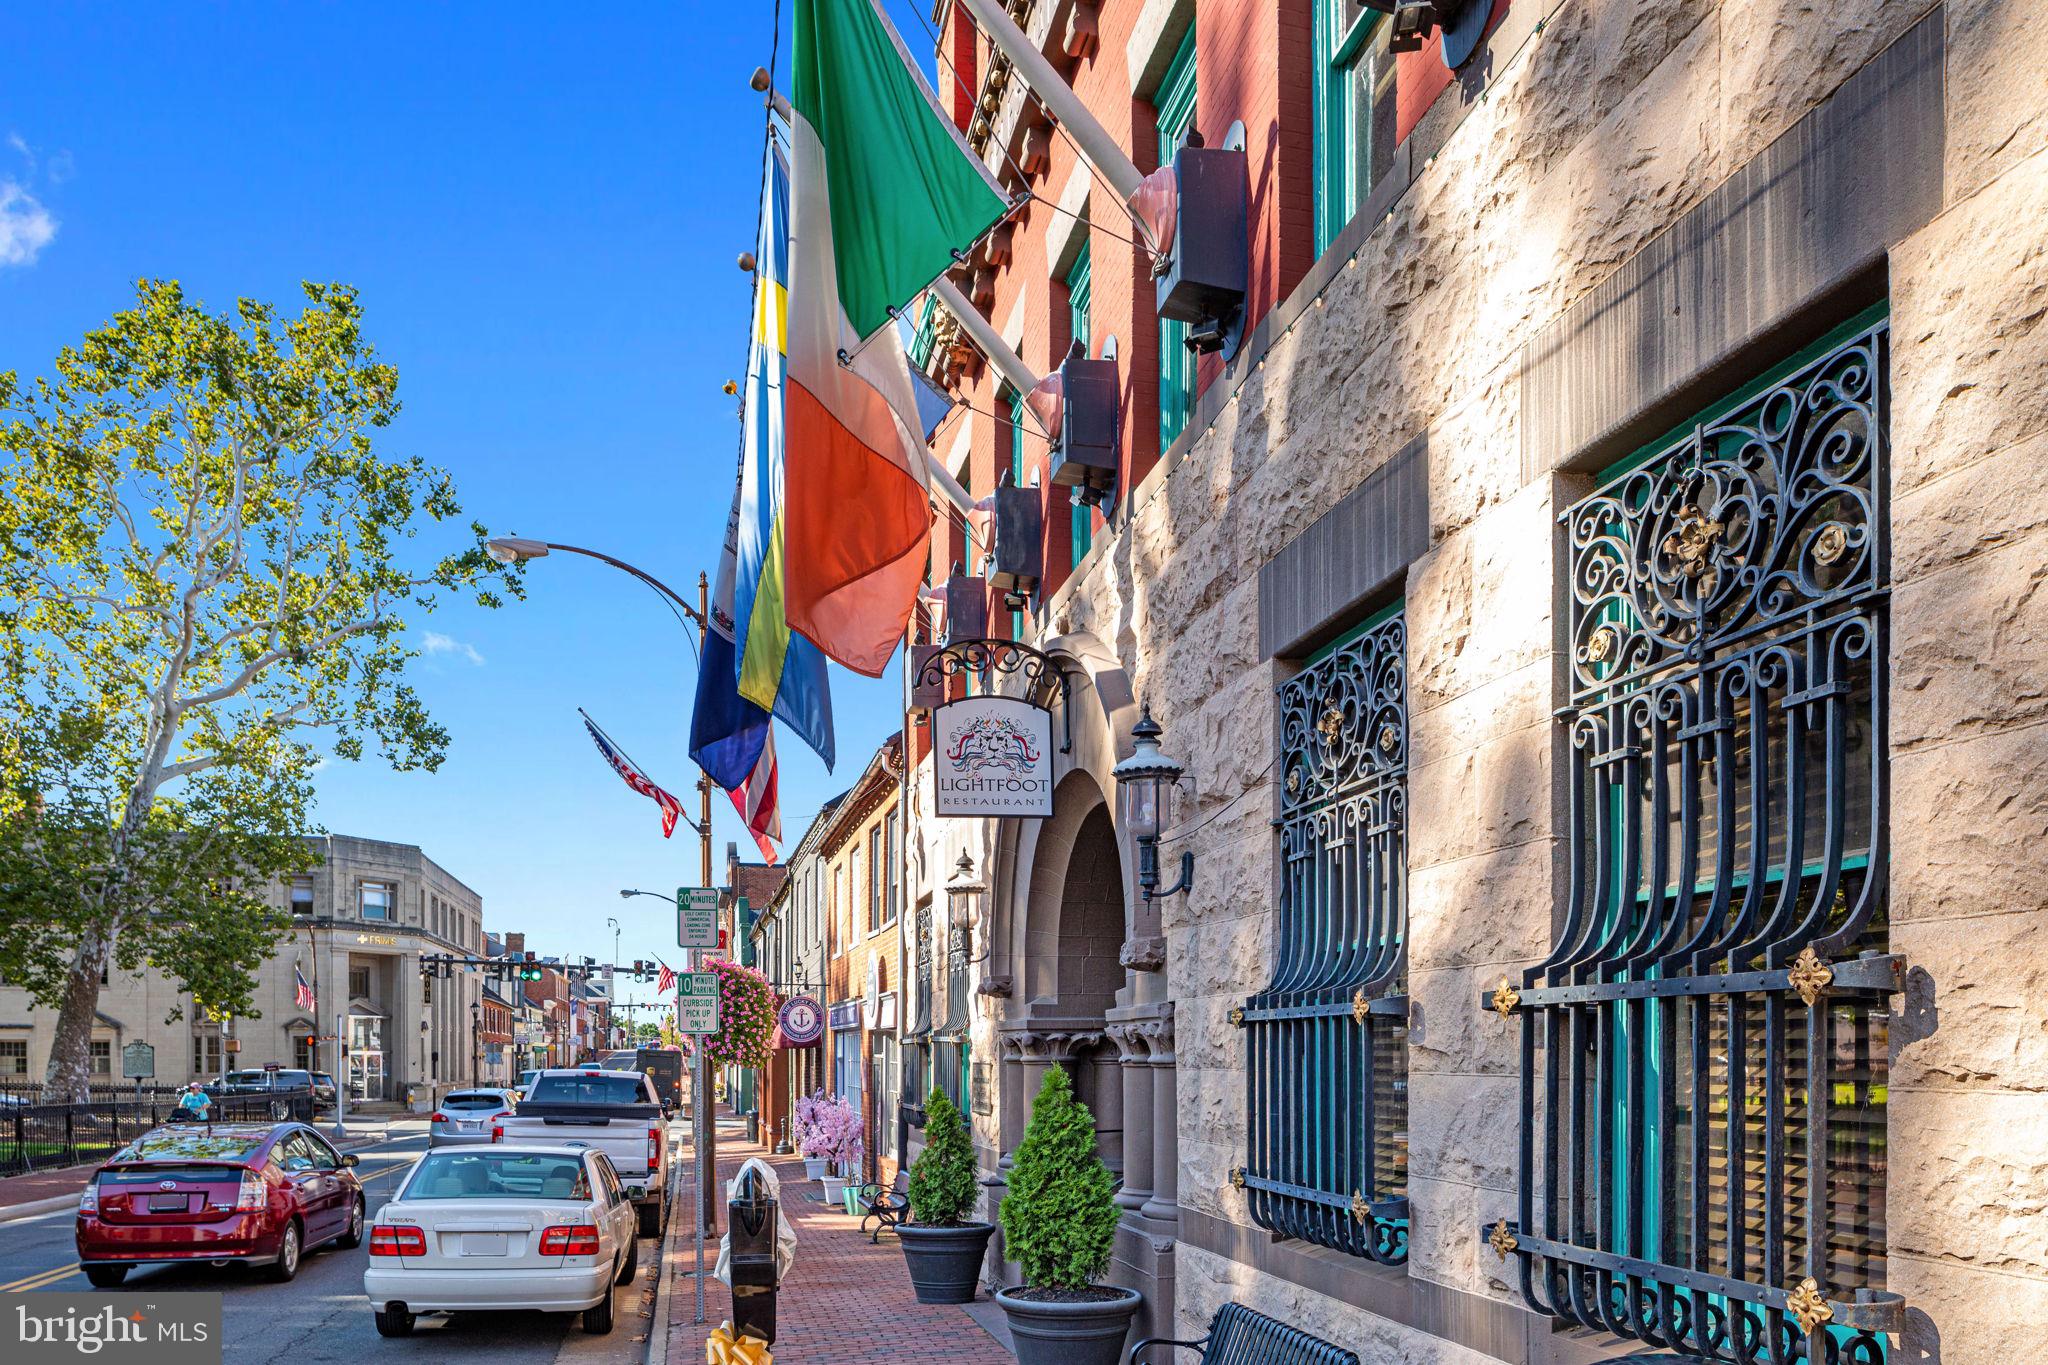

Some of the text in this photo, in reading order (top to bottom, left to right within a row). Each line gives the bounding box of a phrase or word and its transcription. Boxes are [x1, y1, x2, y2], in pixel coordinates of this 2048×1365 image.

[941, 778, 1048, 793] LIGHTFOOT
[943, 797, 1045, 806] RESTAURANT
[679, 893, 716, 905] 20 MINUTES
[680, 976, 714, 992] 10 MINUTE
[693, 986, 716, 994] PARKING
[683, 998, 714, 1007] CURBSIDE
[783, 1004, 791, 1014] THE
[809, 1002, 821, 1014] KNOT
[686, 1009, 711, 1018] PICK UP
[690, 1019, 707, 1028] ONLY
